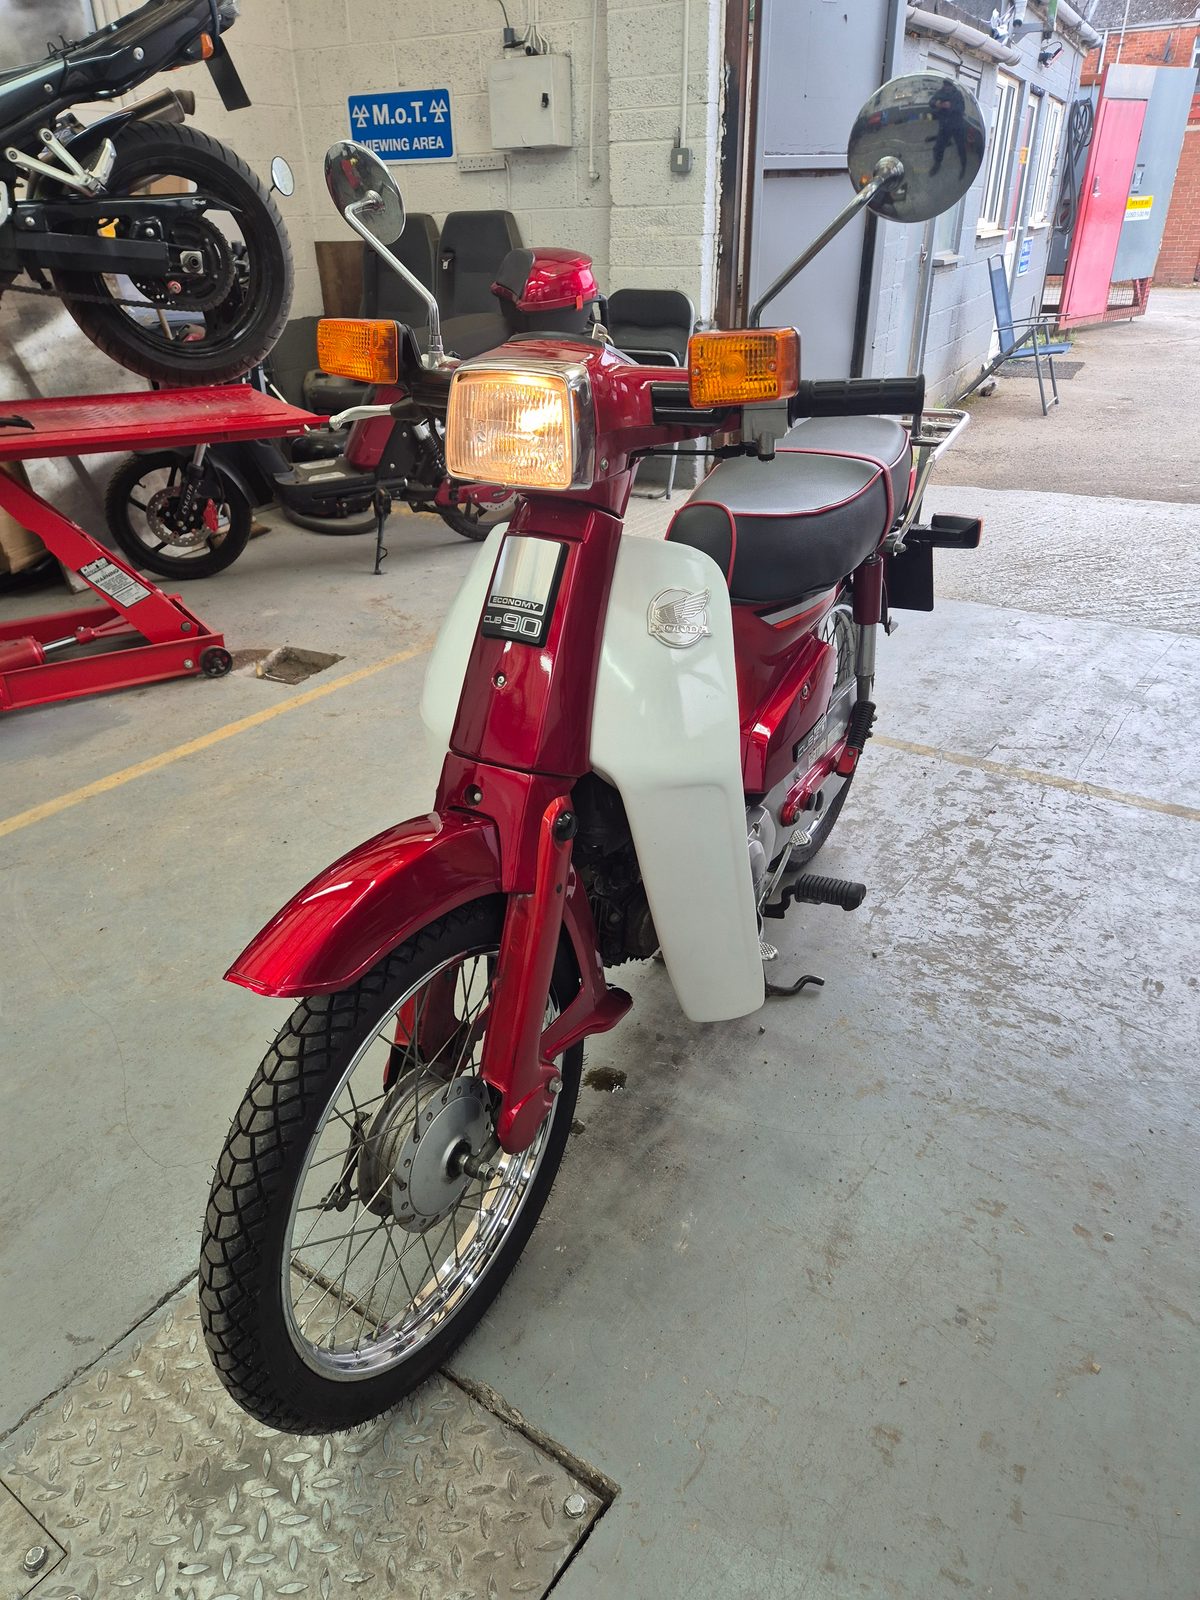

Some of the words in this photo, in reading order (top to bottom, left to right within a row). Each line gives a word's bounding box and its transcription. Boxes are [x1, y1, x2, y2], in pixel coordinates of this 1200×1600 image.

[372, 101, 427, 125] M.o.T.
[412, 136, 445, 151] AREA
[492, 597, 540, 610] ECONOMY
[484, 615, 503, 625] CUB
[501, 612, 543, 638] 90
[650, 623, 710, 635] HONDA
